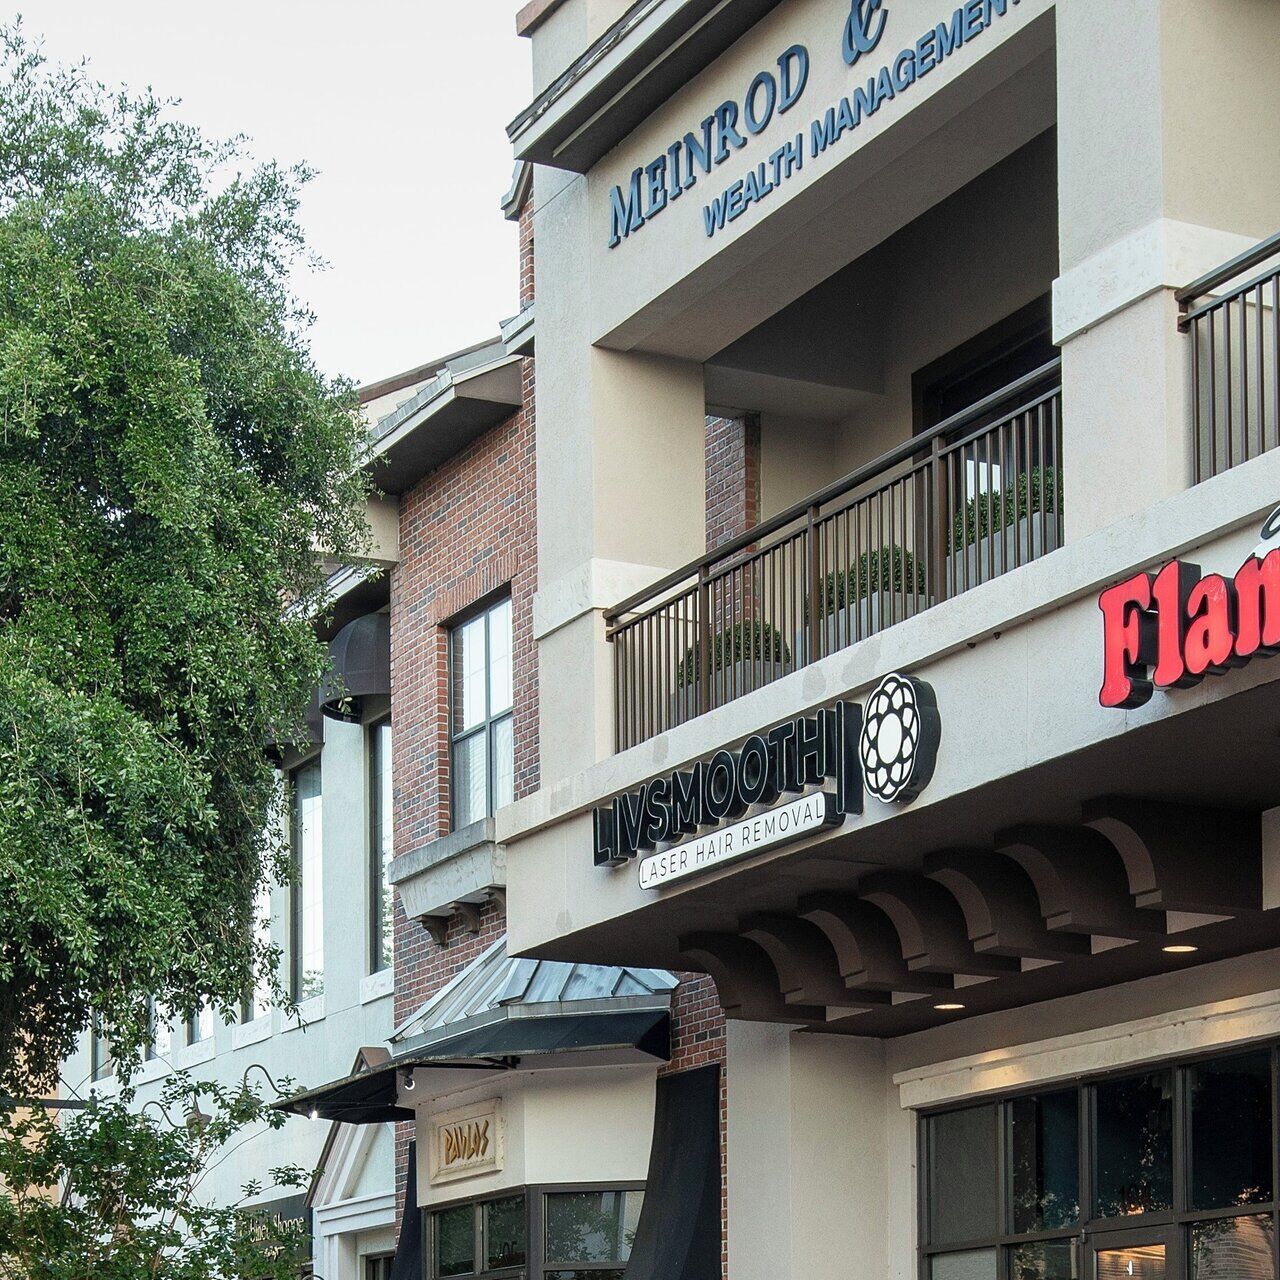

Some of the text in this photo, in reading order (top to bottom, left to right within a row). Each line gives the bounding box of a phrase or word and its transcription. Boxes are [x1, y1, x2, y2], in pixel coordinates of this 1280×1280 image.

[608, 0, 889, 249] MEINROD &
[702, 0, 1021, 237] WEALTH MANAGEMEN
[593, 708, 832, 867] LIVSMOOTH
[641, 803, 824, 884] LASER HAIR REMOVAL
[444, 1119, 490, 1166] PAVLOS
